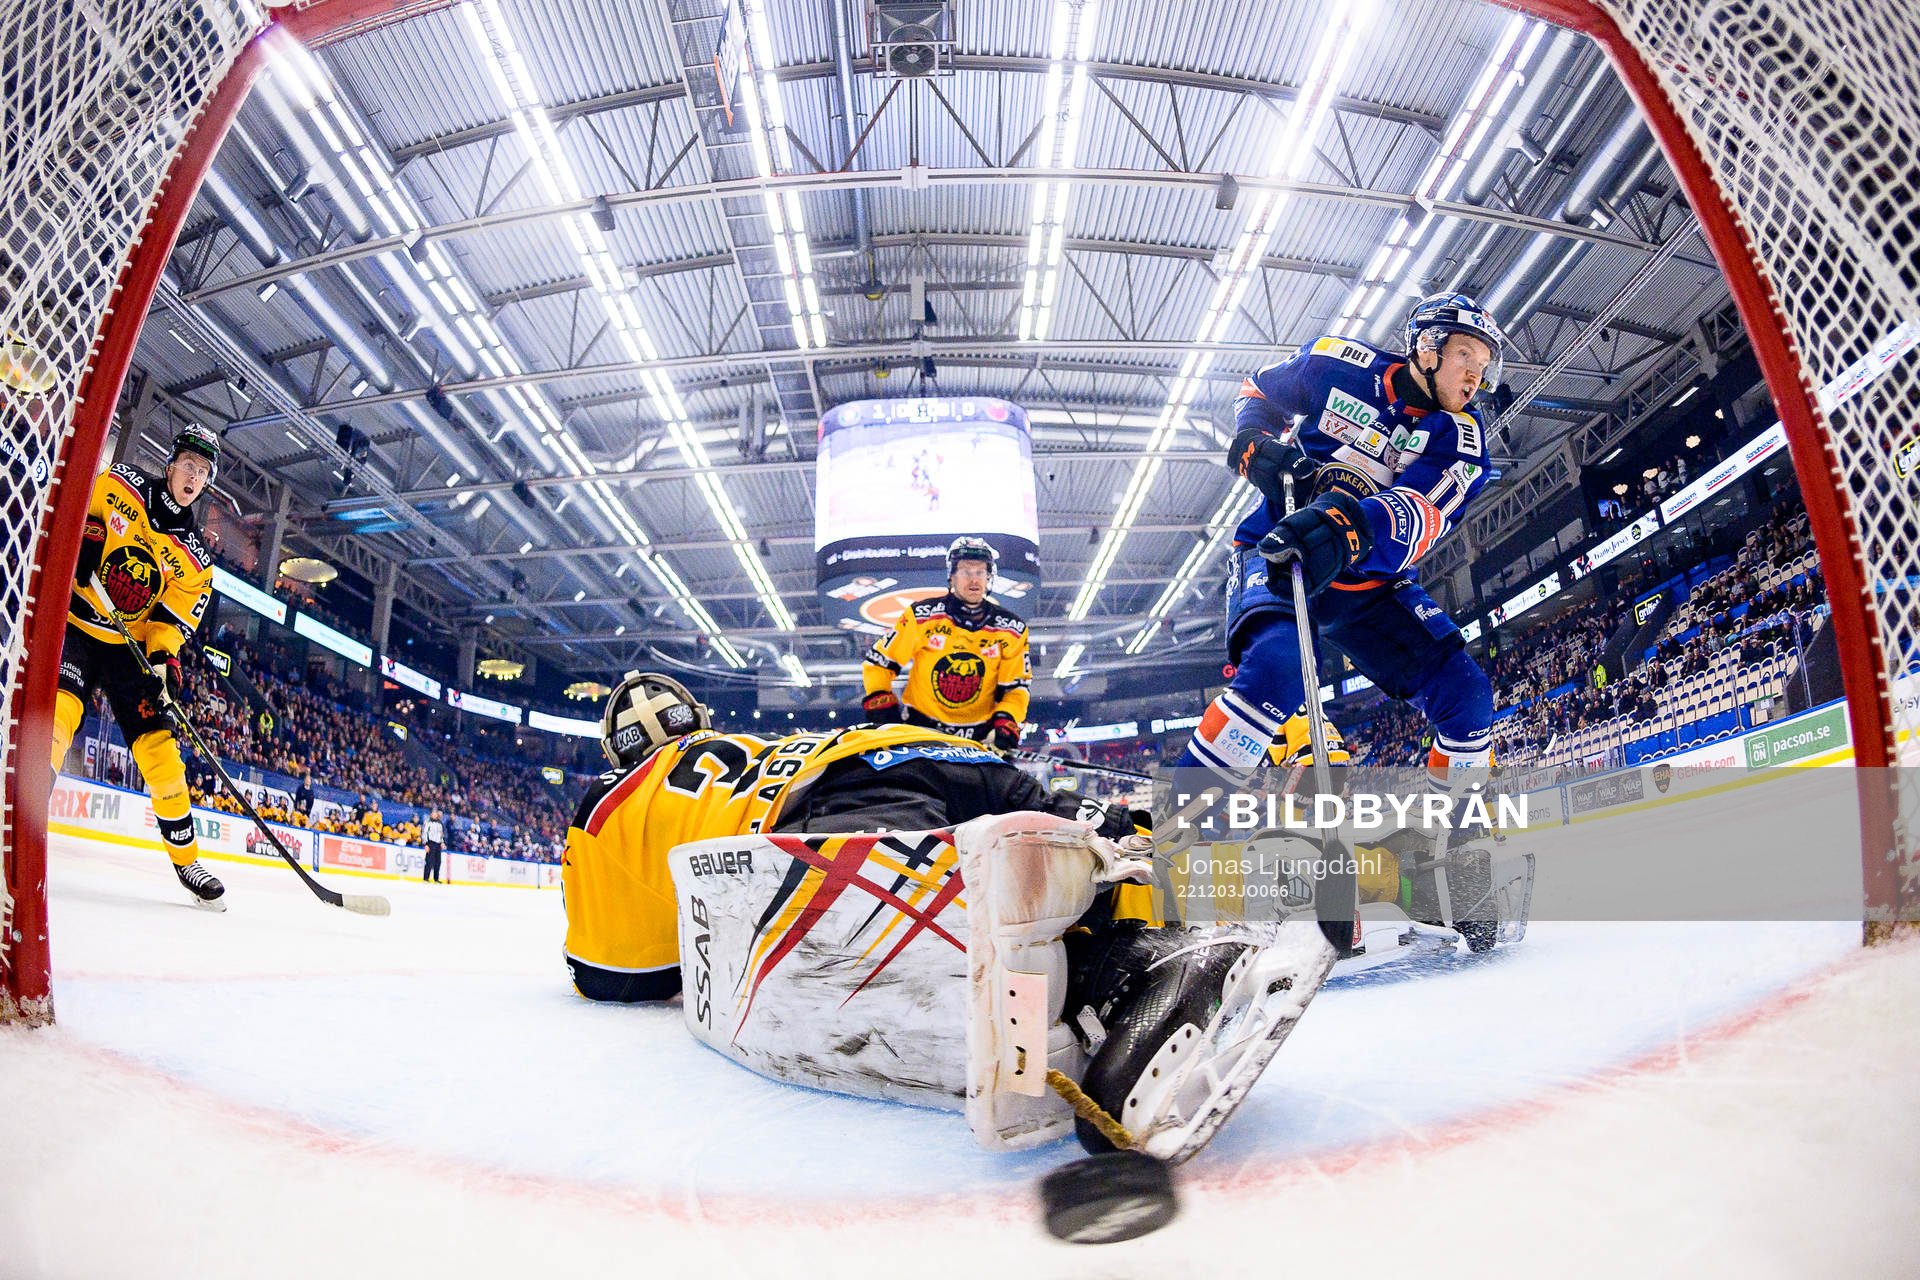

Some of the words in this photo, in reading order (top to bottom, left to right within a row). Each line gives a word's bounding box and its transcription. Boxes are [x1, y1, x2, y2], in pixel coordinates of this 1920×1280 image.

[1332, 397, 1371, 425] wilo
[1356, 440, 1379, 456] BALCO
[112, 463, 144, 487] SSAB
[1335, 471, 1370, 496] LAKERS
[1383, 495, 1407, 538] ALWEX
[184, 532, 211, 567] SSAB
[190, 593, 210, 619] 2
[915, 603, 946, 617] SSAB
[994, 616, 1025, 633] SSAB
[1261, 701, 1288, 721] CCM
[1773, 724, 1831, 757] pacson.se
[1677, 754, 1736, 780] GEHAB.com
[1753, 749, 1767, 762] ON
[690, 894, 712, 1031] SSAB
